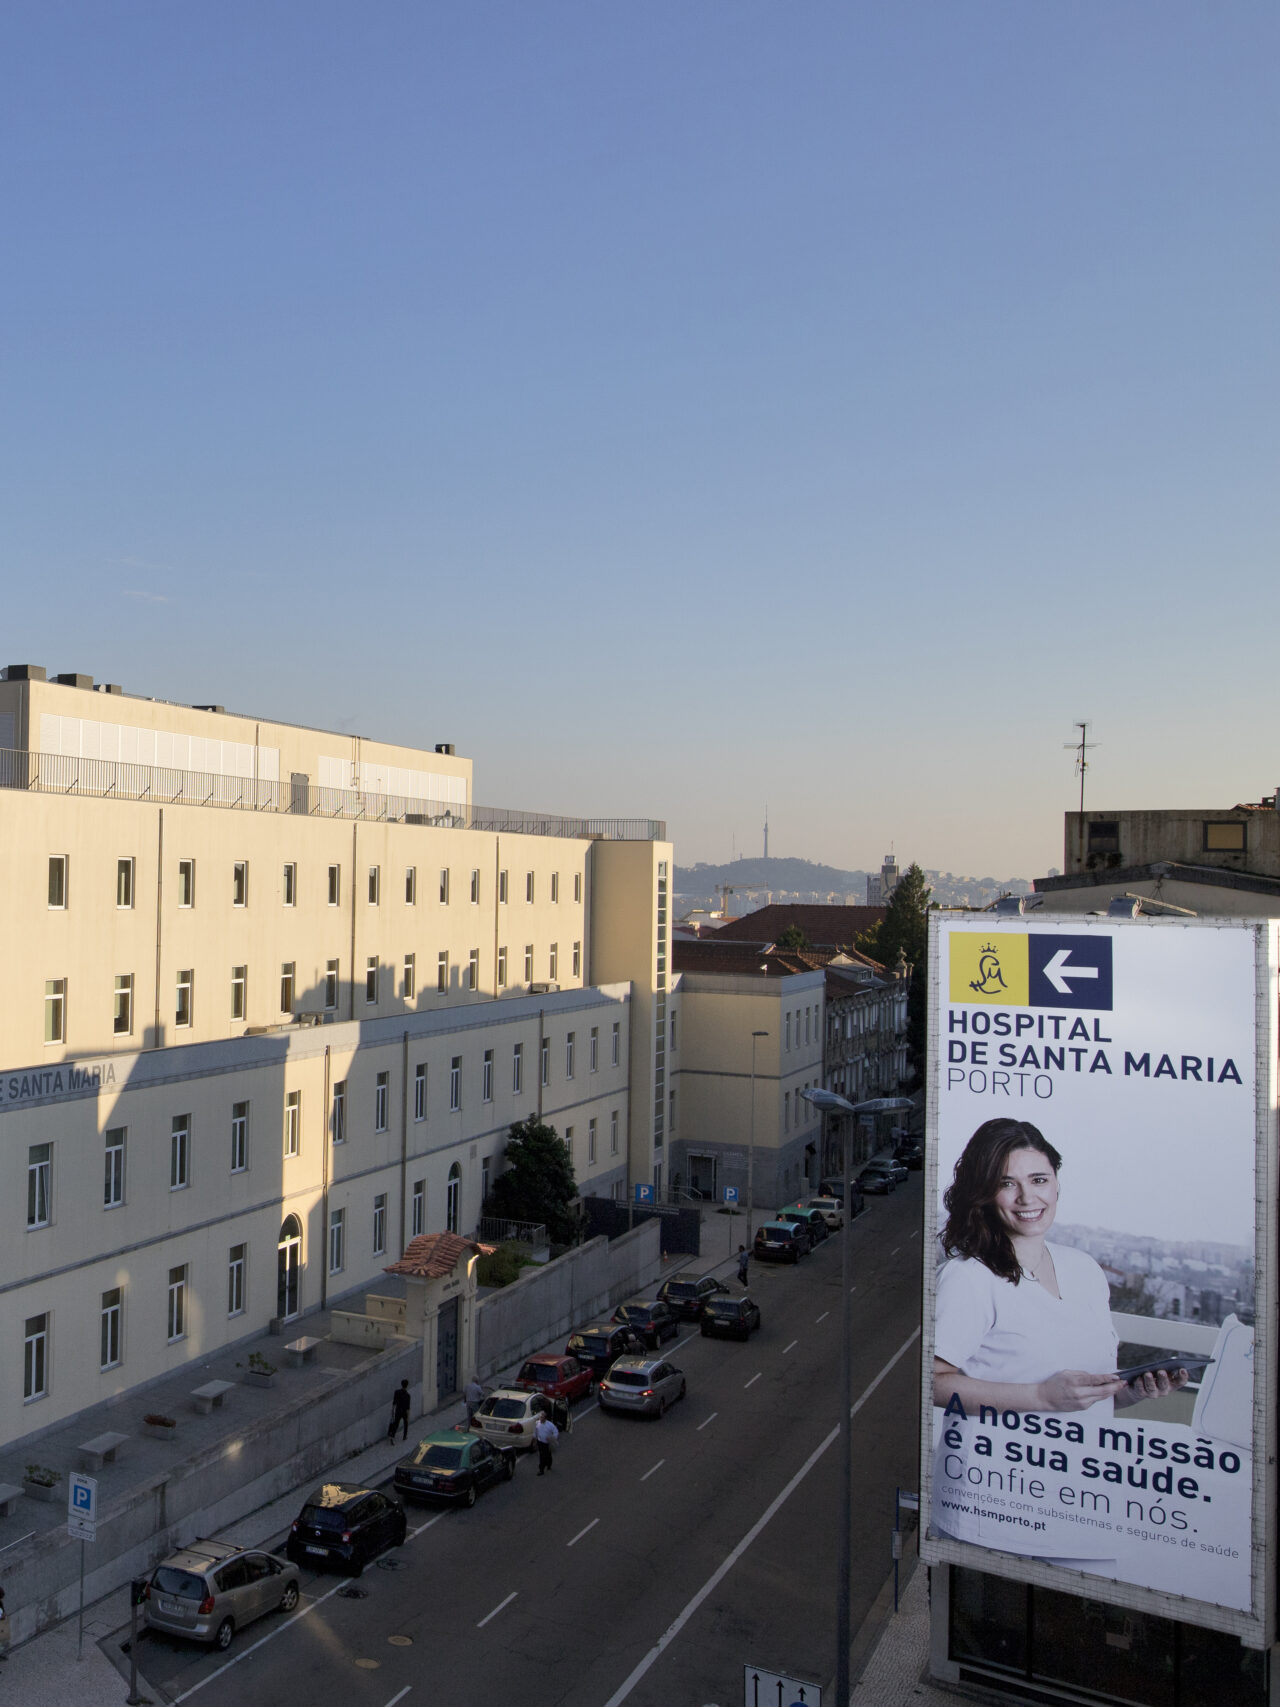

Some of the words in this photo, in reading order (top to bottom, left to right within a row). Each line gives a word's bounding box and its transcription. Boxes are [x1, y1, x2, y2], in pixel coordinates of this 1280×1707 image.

[948, 1009, 1112, 1043] HOSPITAL
[948, 1040, 988, 1065] DE
[998, 1043, 1112, 1075] SANTA
[1124, 1051, 1243, 1084] MARIA
[8, 1071, 63, 1099] SANTA
[68, 1063, 116, 1090] MARIA
[948, 1068, 1053, 1099] PORTO
[640, 1187, 649, 1199] P
[726, 1188, 736, 1200] P
[944, 1392, 968, 1420] A
[979, 1402, 1084, 1444] nossa
[1099, 1426, 1240, 1474] missão
[944, 1426, 963, 1449] é
[974, 1435, 992, 1457] a
[1004, 1441, 1068, 1473] sua
[1081, 1457, 1212, 1503] saúde.
[76, 1487, 88, 1506] P
[944, 1454, 1045, 1499] Confie
[1059, 1488, 1110, 1514] em
[1126, 1498, 1198, 1533] nós.
[941, 1499, 1046, 1532] www.hsmporto.pt
[941, 1486, 1006, 1506] convenções
[1009, 1500, 1034, 1513] com
[1037, 1504, 1112, 1531] subsistemas
[1116, 1525, 1123, 1533] e
[1126, 1527, 1177, 1547] seguros
[1180, 1537, 1196, 1549] de
[1200, 1541, 1239, 1559] saúde
